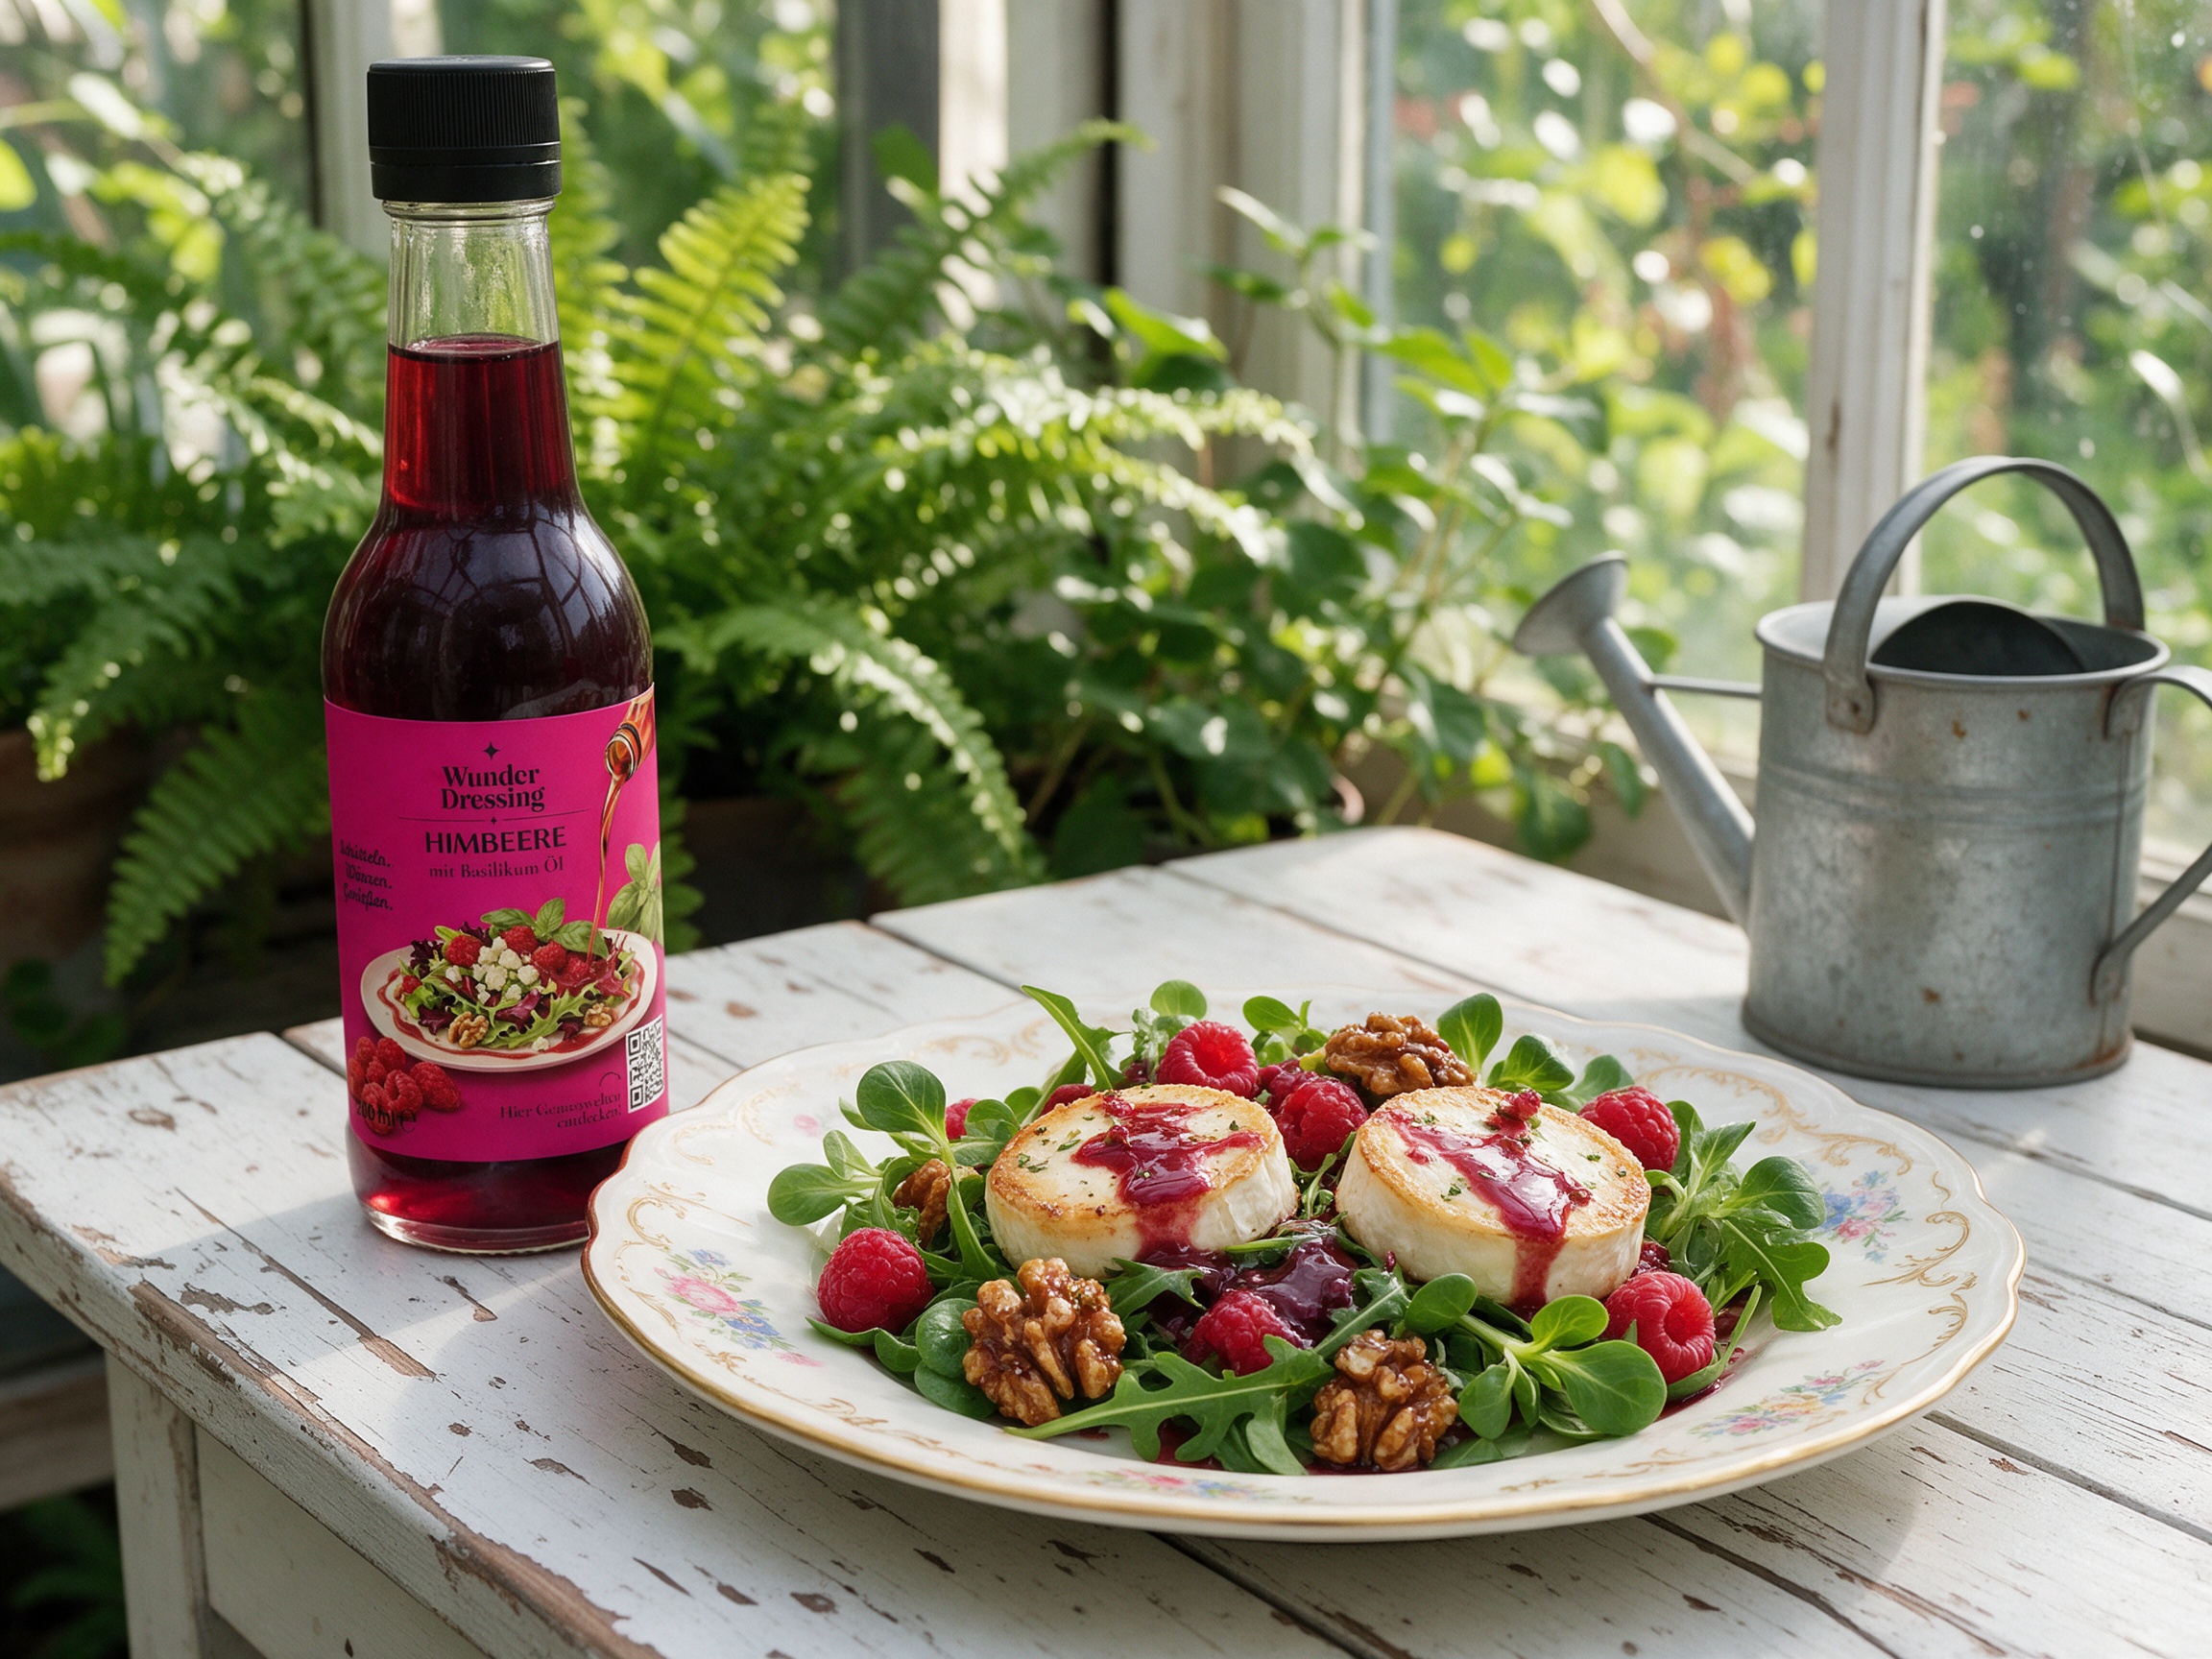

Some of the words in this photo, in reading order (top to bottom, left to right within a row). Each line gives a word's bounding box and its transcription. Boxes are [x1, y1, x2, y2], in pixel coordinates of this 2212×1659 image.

[441, 763, 541, 787] Wunder
[441, 786, 545, 812] Dressing
[425, 826, 566, 854] HIMBEERE
[429, 863, 455, 878] mit
[461, 860, 539, 878] Basilikum
[544, 855, 564, 873] Öl
[500, 1105, 533, 1118] Hier
